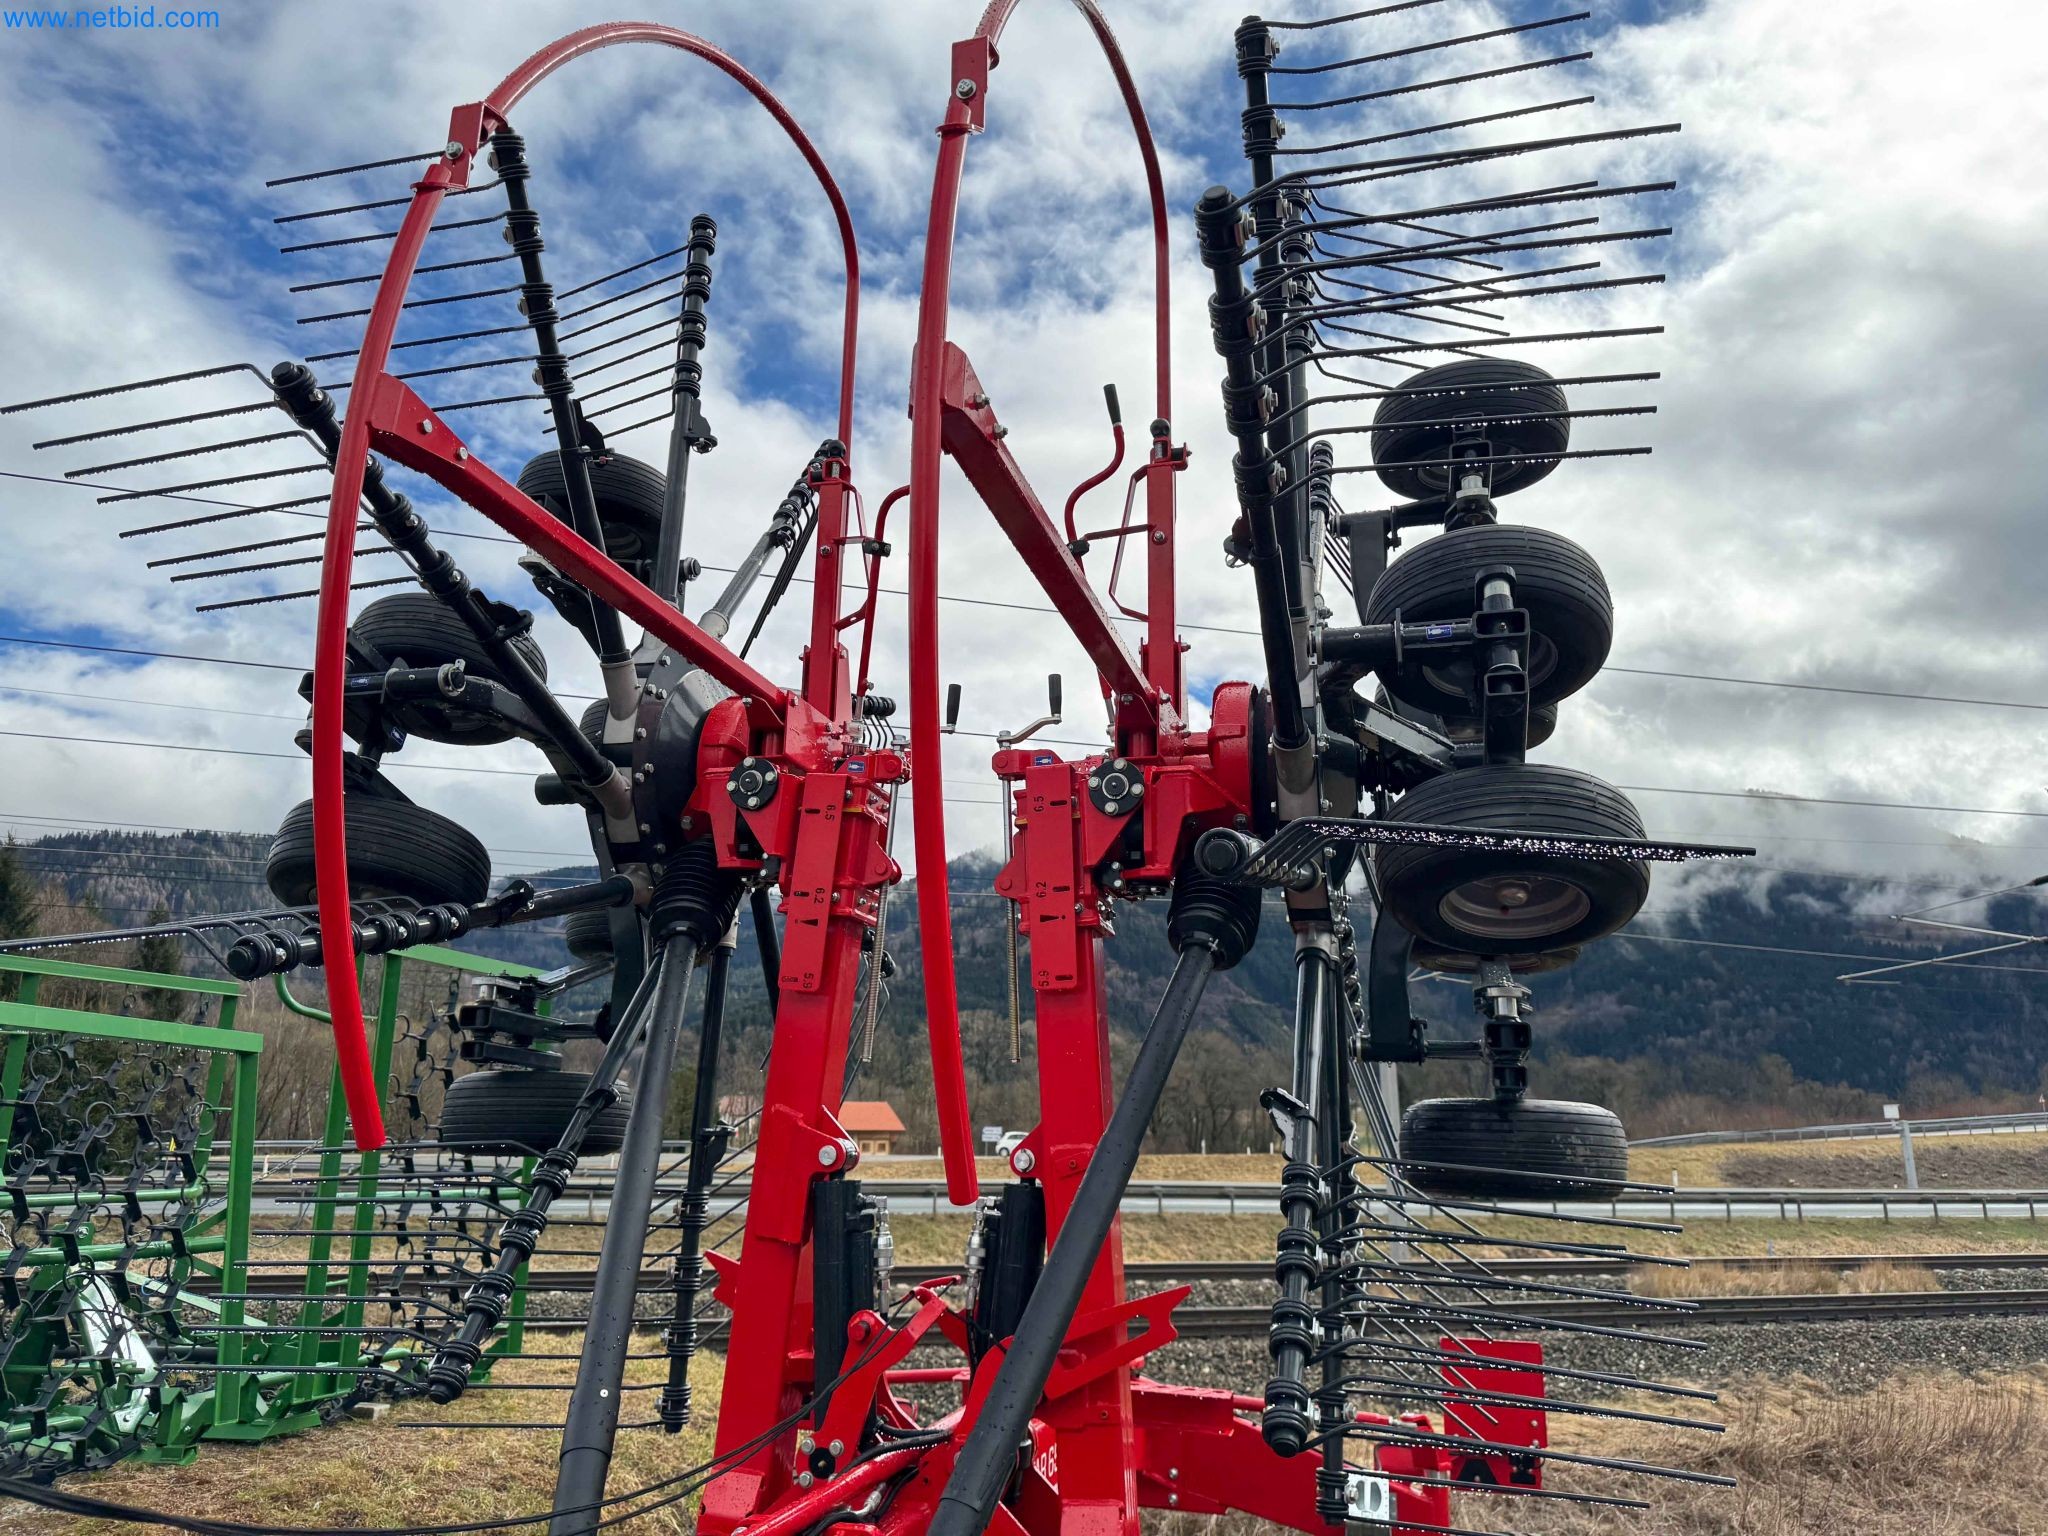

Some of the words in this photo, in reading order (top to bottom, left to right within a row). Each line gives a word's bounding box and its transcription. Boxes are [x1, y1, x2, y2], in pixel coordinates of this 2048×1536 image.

[825, 804, 836, 821] 6.5
[1033, 795, 1045, 813] 6.5
[813, 887, 825, 904] 6.2
[1035, 881, 1047, 898] 6.2
